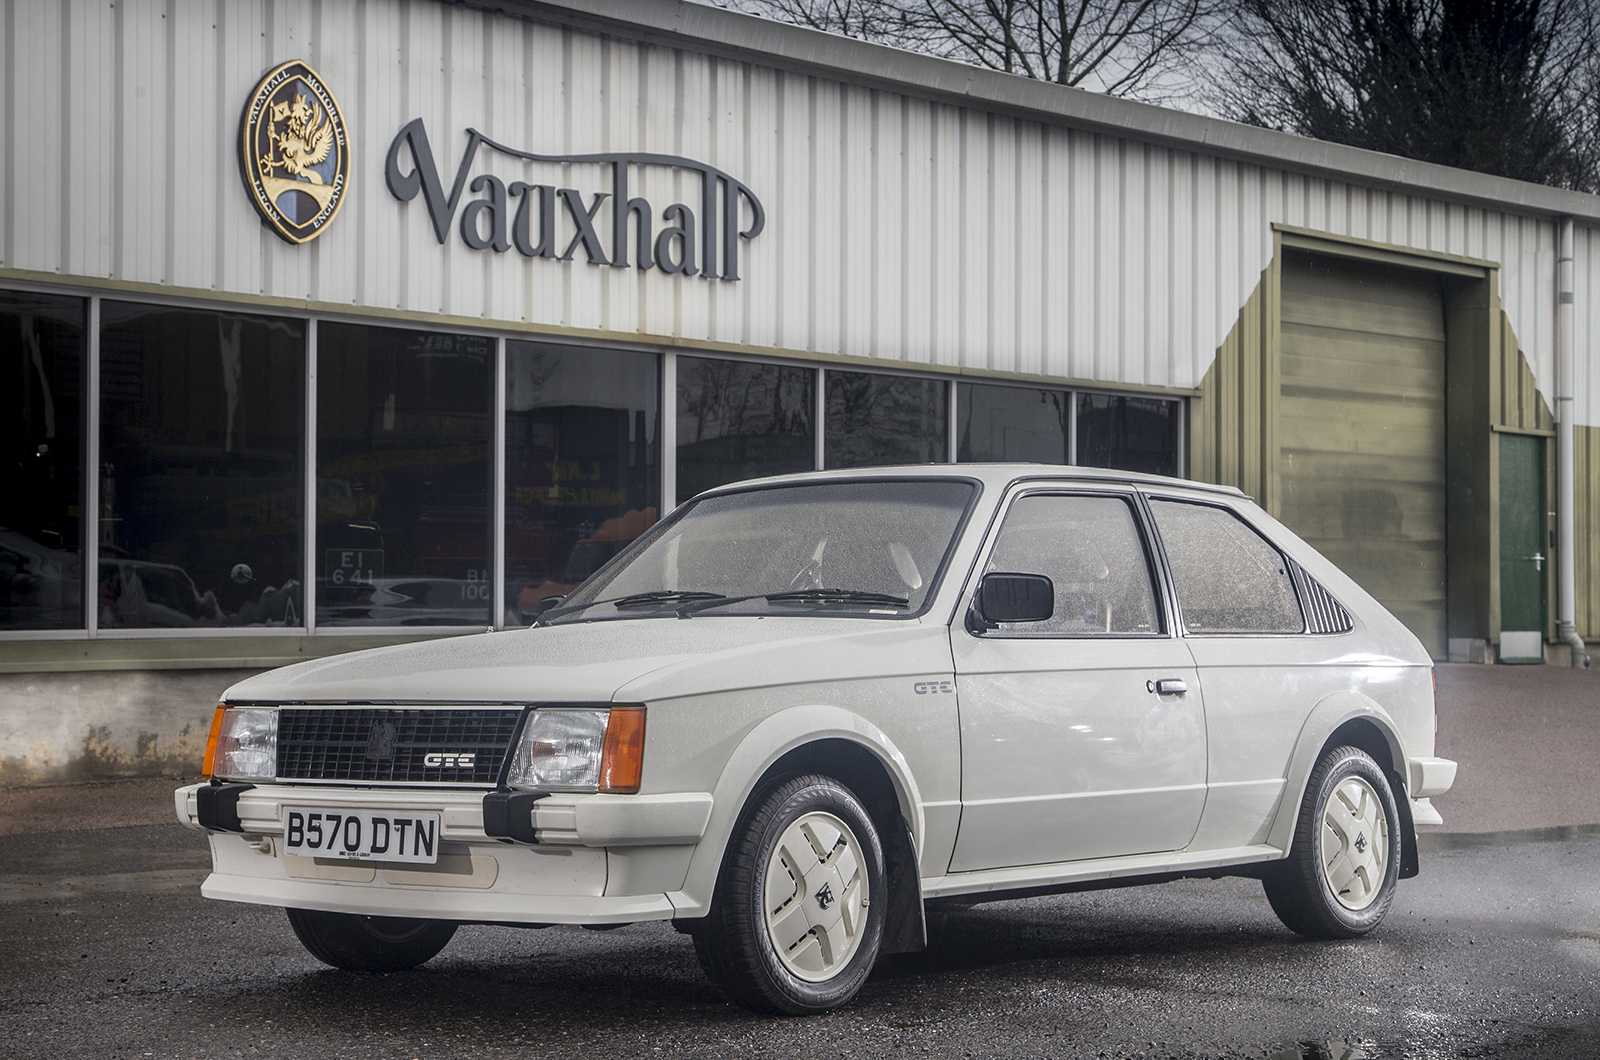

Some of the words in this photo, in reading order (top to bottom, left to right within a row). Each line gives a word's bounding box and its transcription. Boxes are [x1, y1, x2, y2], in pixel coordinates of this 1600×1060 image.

[250, 70, 290, 124] VAUXHALL
[307, 73, 339, 123] MOTORS
[313, 173, 344, 228] ENGLAND
[385, 117, 765, 281] Vauxhall
[332, 569, 373, 585] 641
[914, 681, 952, 694] GTE
[424, 753, 476, 767] GTE
[287, 812, 361, 852] B570
[370, 817, 435, 857] DTN
